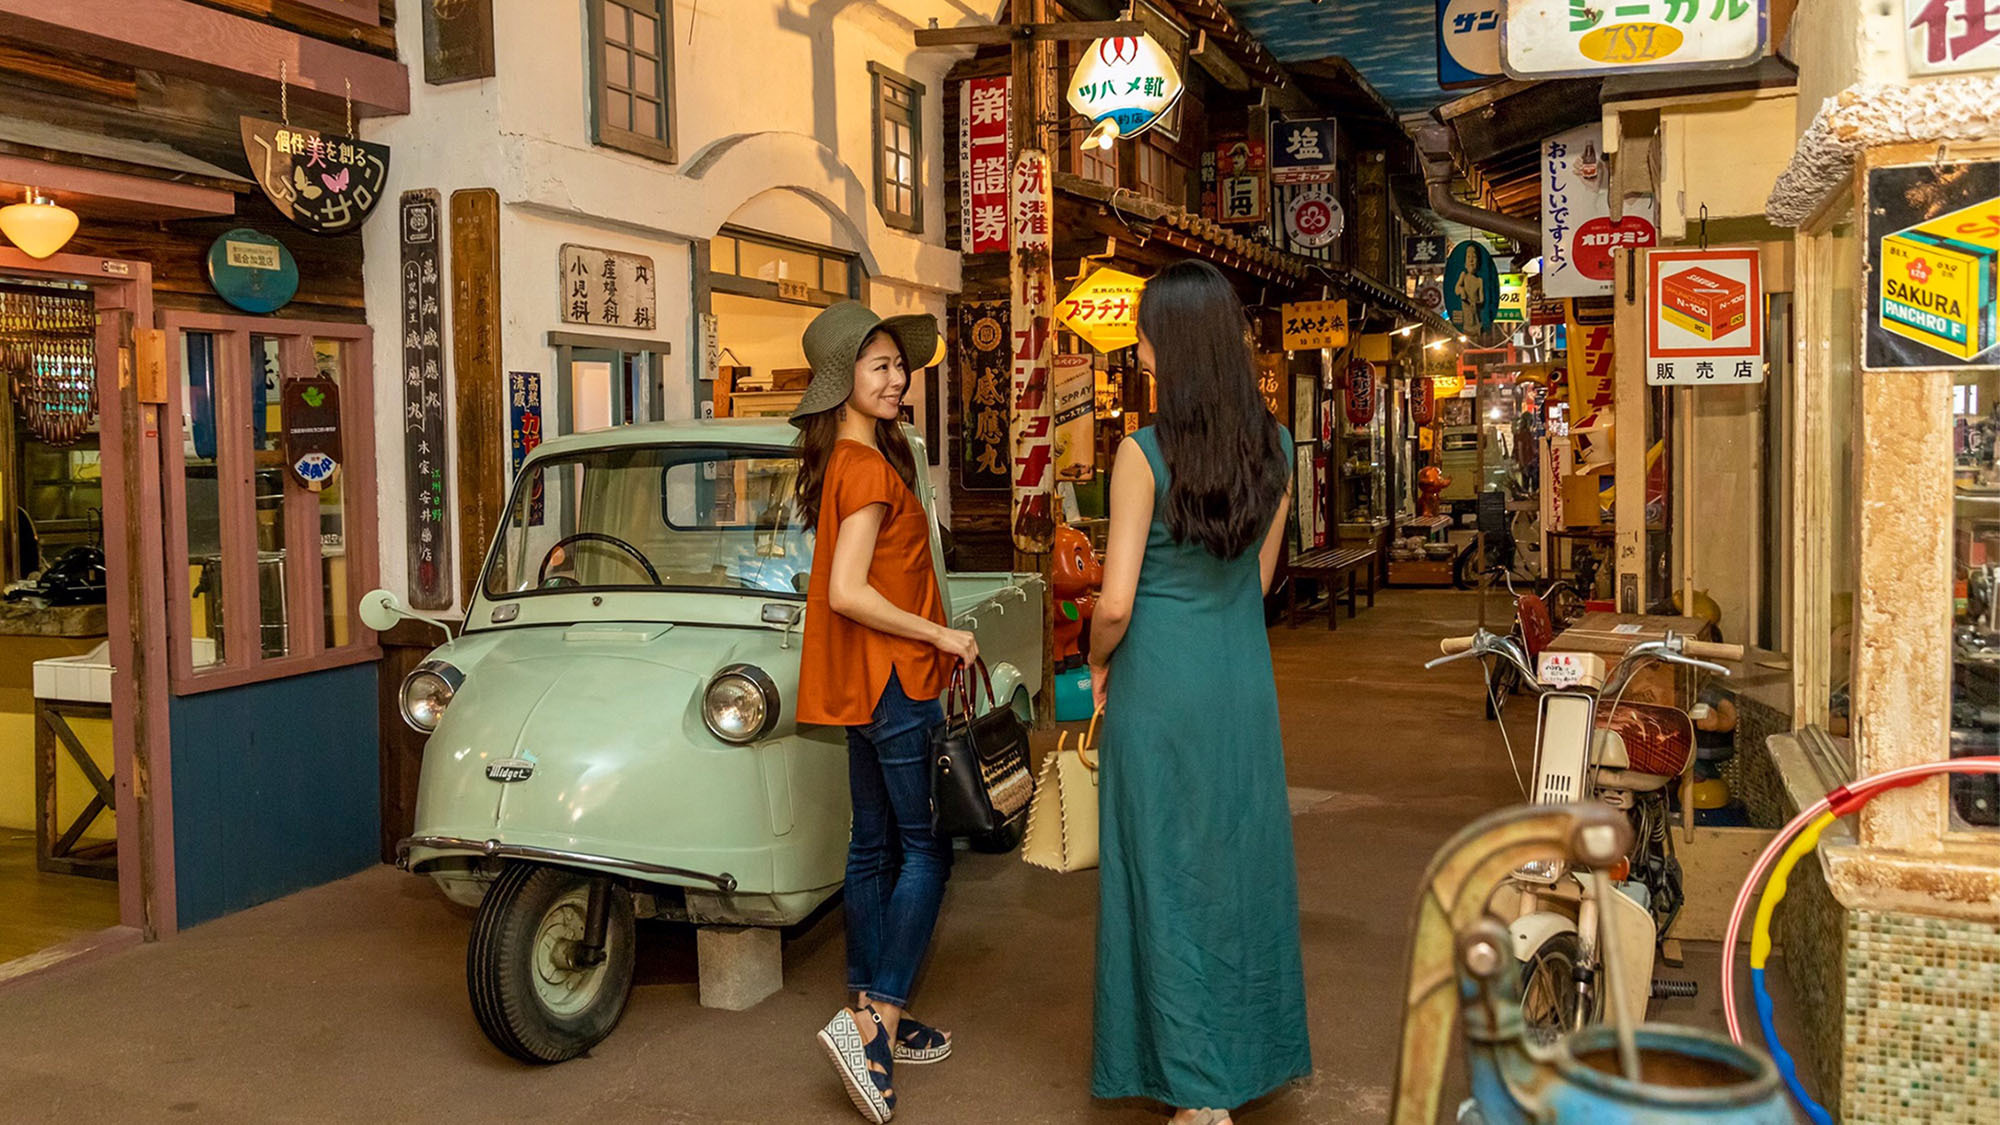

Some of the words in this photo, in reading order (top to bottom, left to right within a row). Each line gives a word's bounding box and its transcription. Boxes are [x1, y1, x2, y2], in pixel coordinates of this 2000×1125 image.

[275, 130, 367, 168] 個性美を創る
[1286, 126, 1324, 160] 塩
[1229, 178, 1252, 217] 仁丹
[1581, 231, 1650, 247] オロナミン
[633, 265, 651, 327] 内科
[1676, 296, 1708, 317] N-100
[1886, 278, 1961, 319] SAKURA
[1885, 299, 1947, 333] PANCHRO
[1951, 321, 1961, 338] F
[1656, 361, 1753, 380] 販売店
[1061, 384, 1092, 405] SPRAY
[489, 766, 528, 781] Midget
